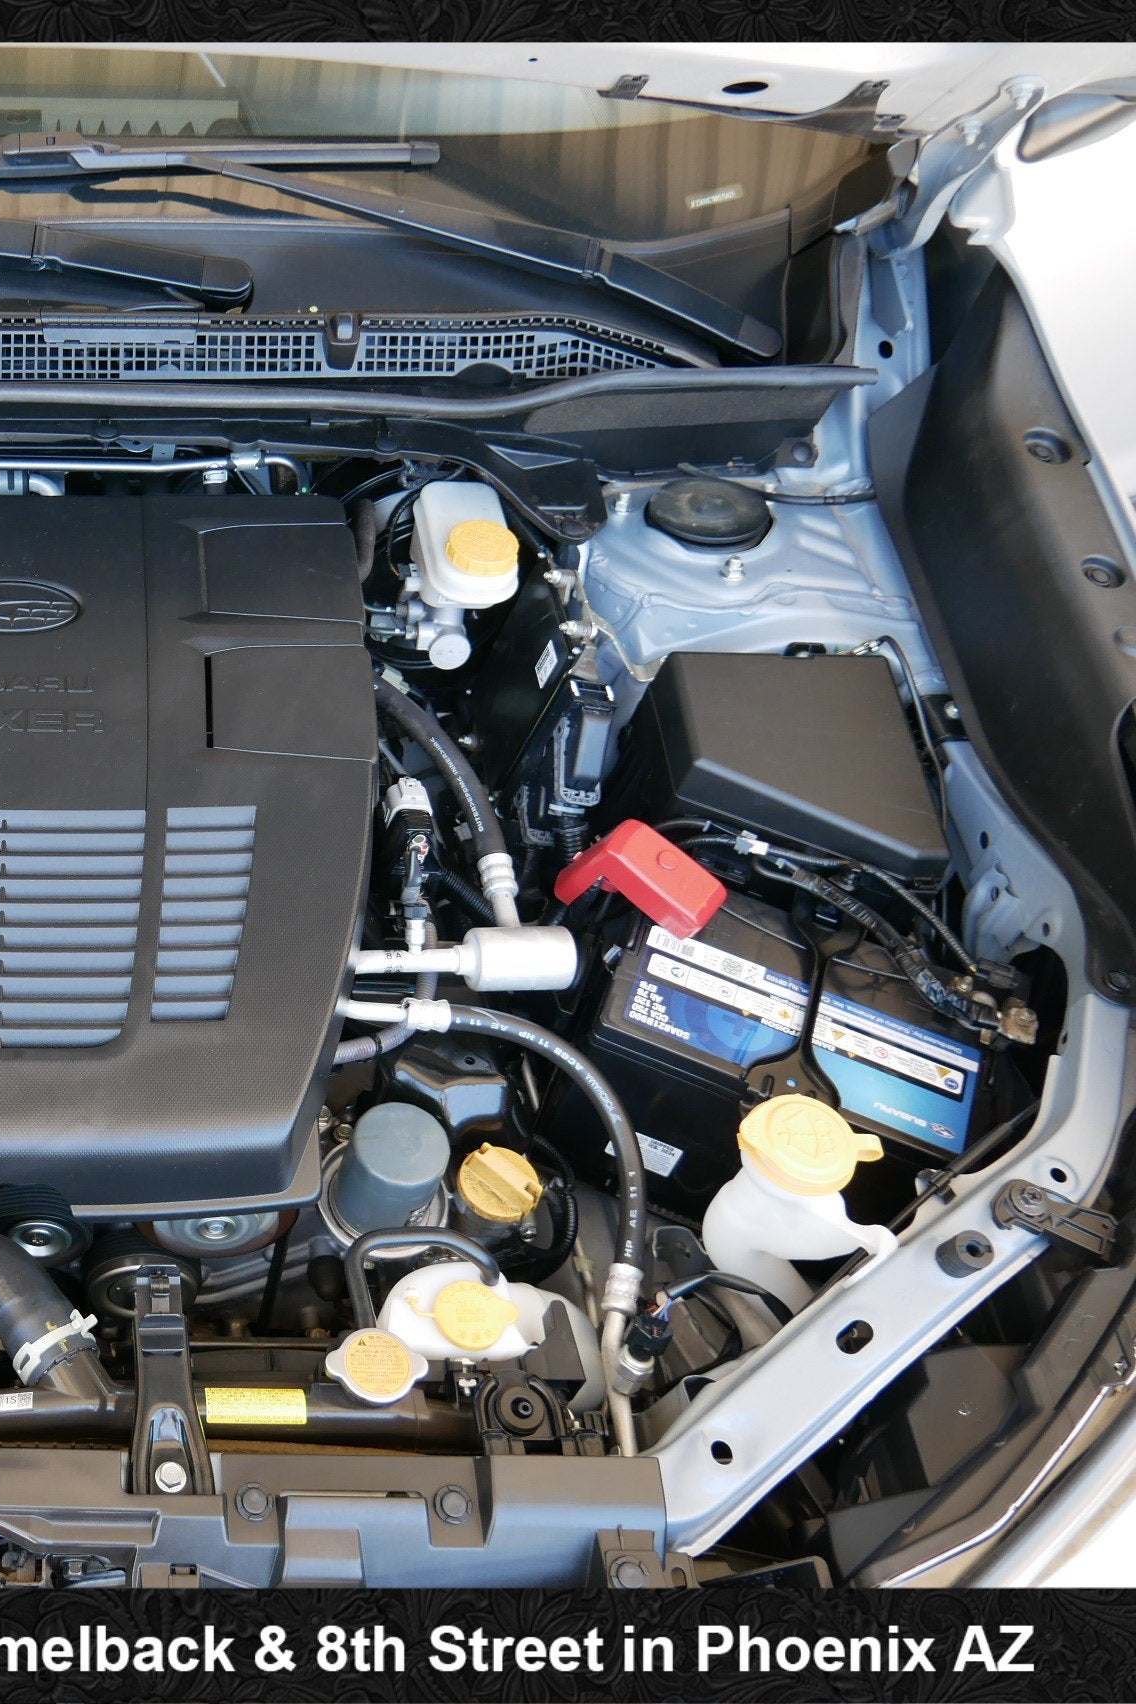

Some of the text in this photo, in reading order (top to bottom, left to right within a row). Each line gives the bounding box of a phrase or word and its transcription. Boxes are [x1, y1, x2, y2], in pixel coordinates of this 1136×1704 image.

[639, 980, 658, 993] EFB
[634, 994, 667, 1014] RC 120
[631, 1002, 669, 1023] CCA 750
[469, 1018, 482, 1026] 11
[490, 1022, 509, 1032] AE
[518, 1031, 535, 1042] HP
[538, 1038, 550, 1048] 11
[585, 1073, 615, 1112] YOKOHAMA
[874, 1102, 928, 1127] SUBARU
[629, 1186, 637, 1198] 11
[629, 1209, 637, 1228] AE
[624, 1240, 634, 1257] HP
